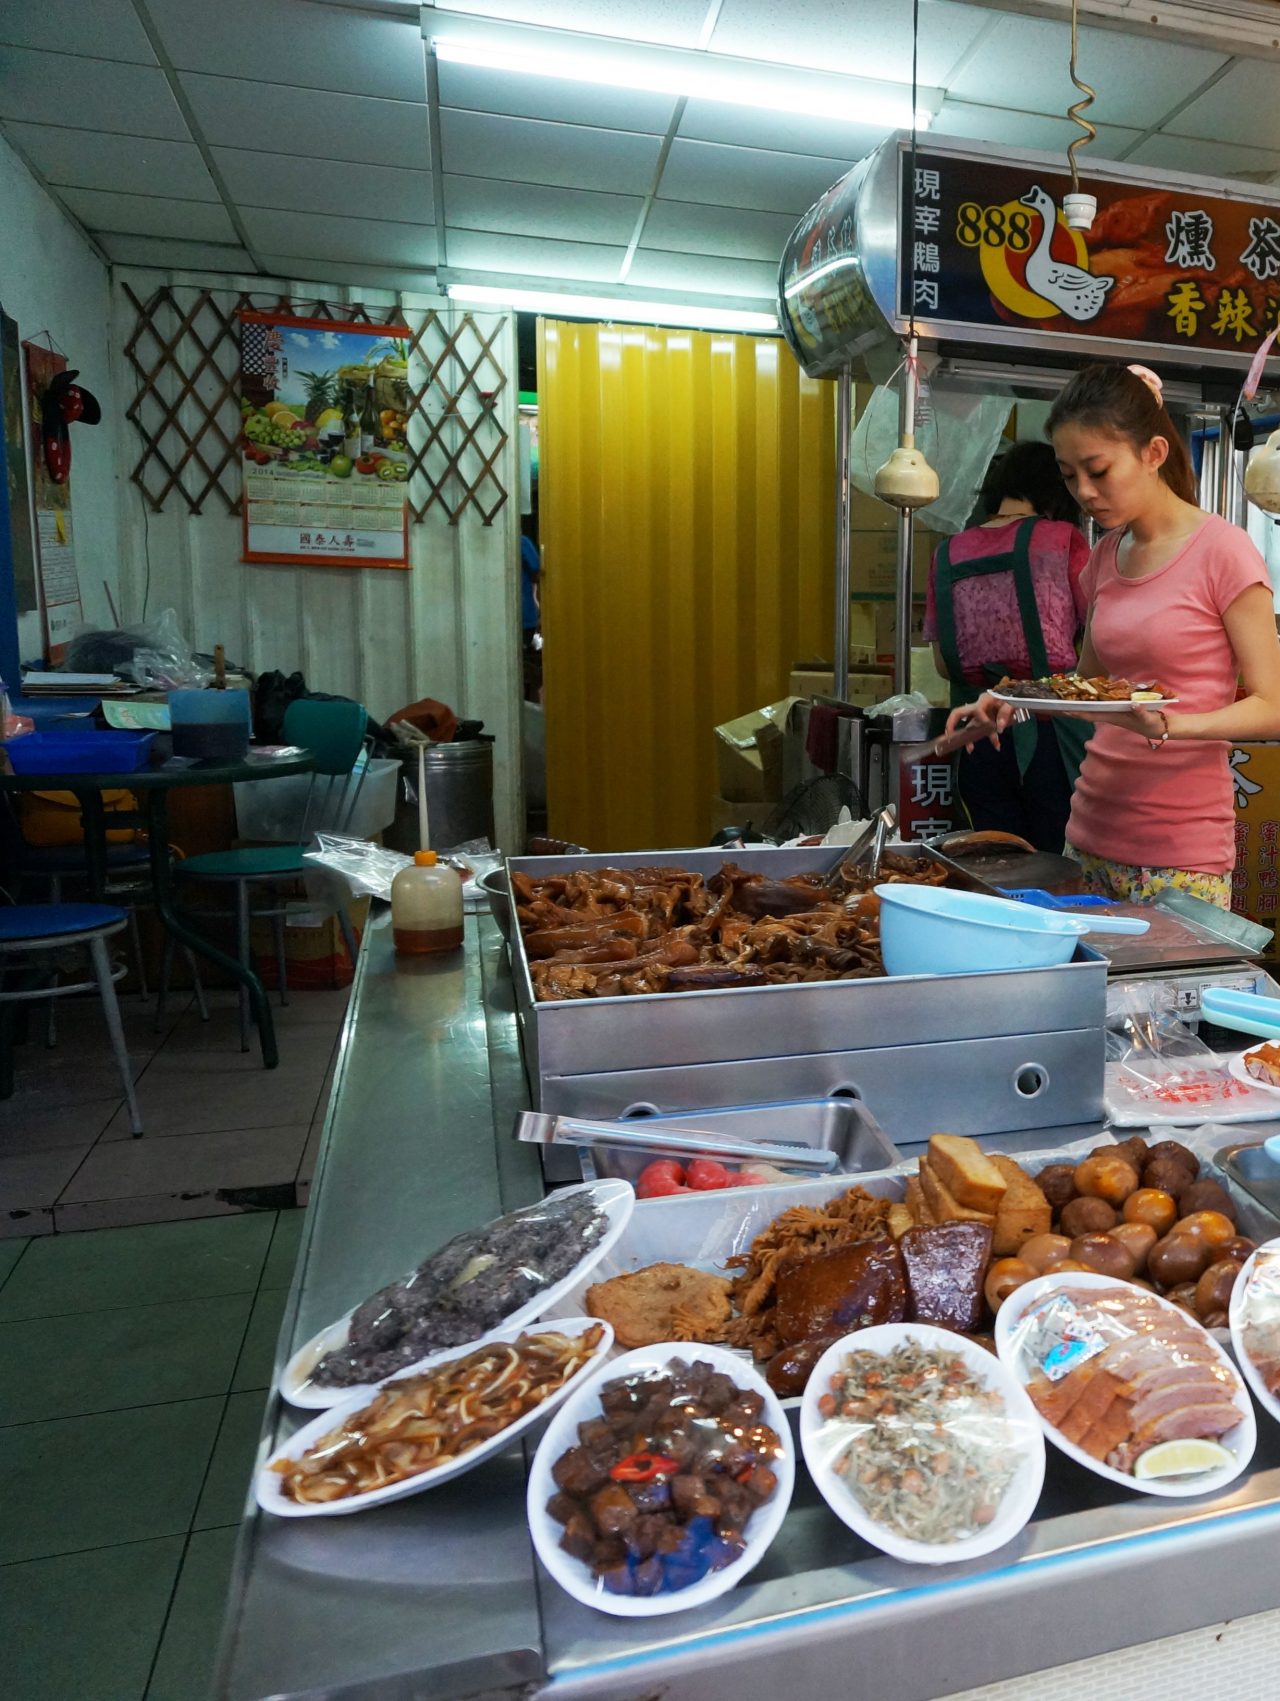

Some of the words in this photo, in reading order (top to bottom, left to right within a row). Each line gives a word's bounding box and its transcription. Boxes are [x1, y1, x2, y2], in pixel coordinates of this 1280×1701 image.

[913, 167, 941, 310] 現宰鵝肉
[956, 202, 1032, 253] 888
[252, 467, 275, 476] 2014
